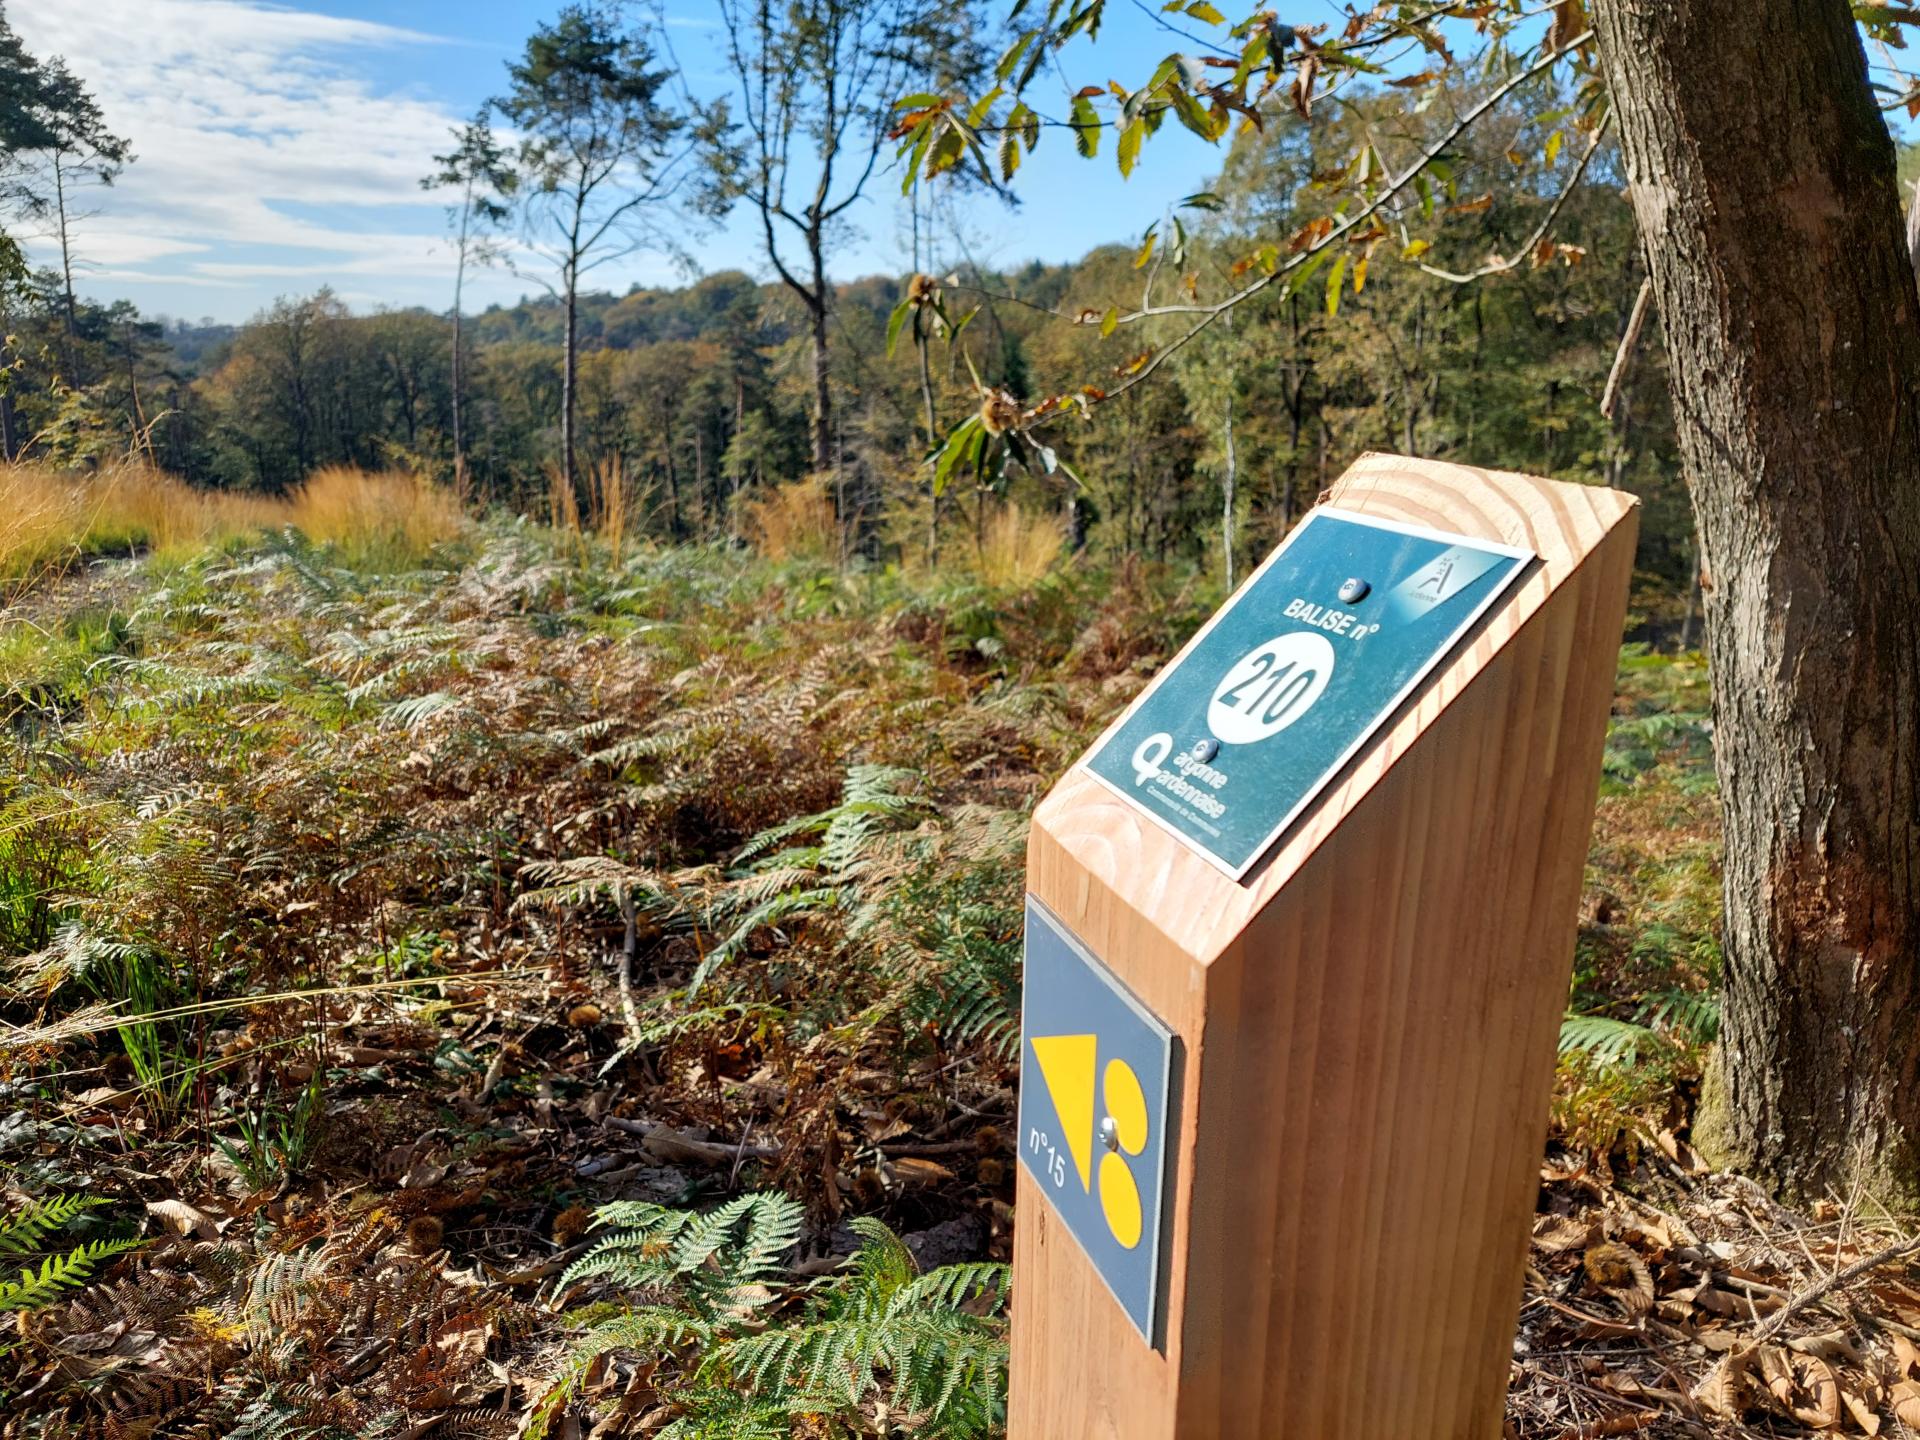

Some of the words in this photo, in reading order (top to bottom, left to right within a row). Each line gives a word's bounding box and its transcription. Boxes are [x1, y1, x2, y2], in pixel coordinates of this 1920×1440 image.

[1283, 598, 1357, 635] BALISE
[1217, 652, 1317, 725] 210
[1173, 752, 1228, 789] argonne
[1156, 769, 1226, 819] ardennaise
